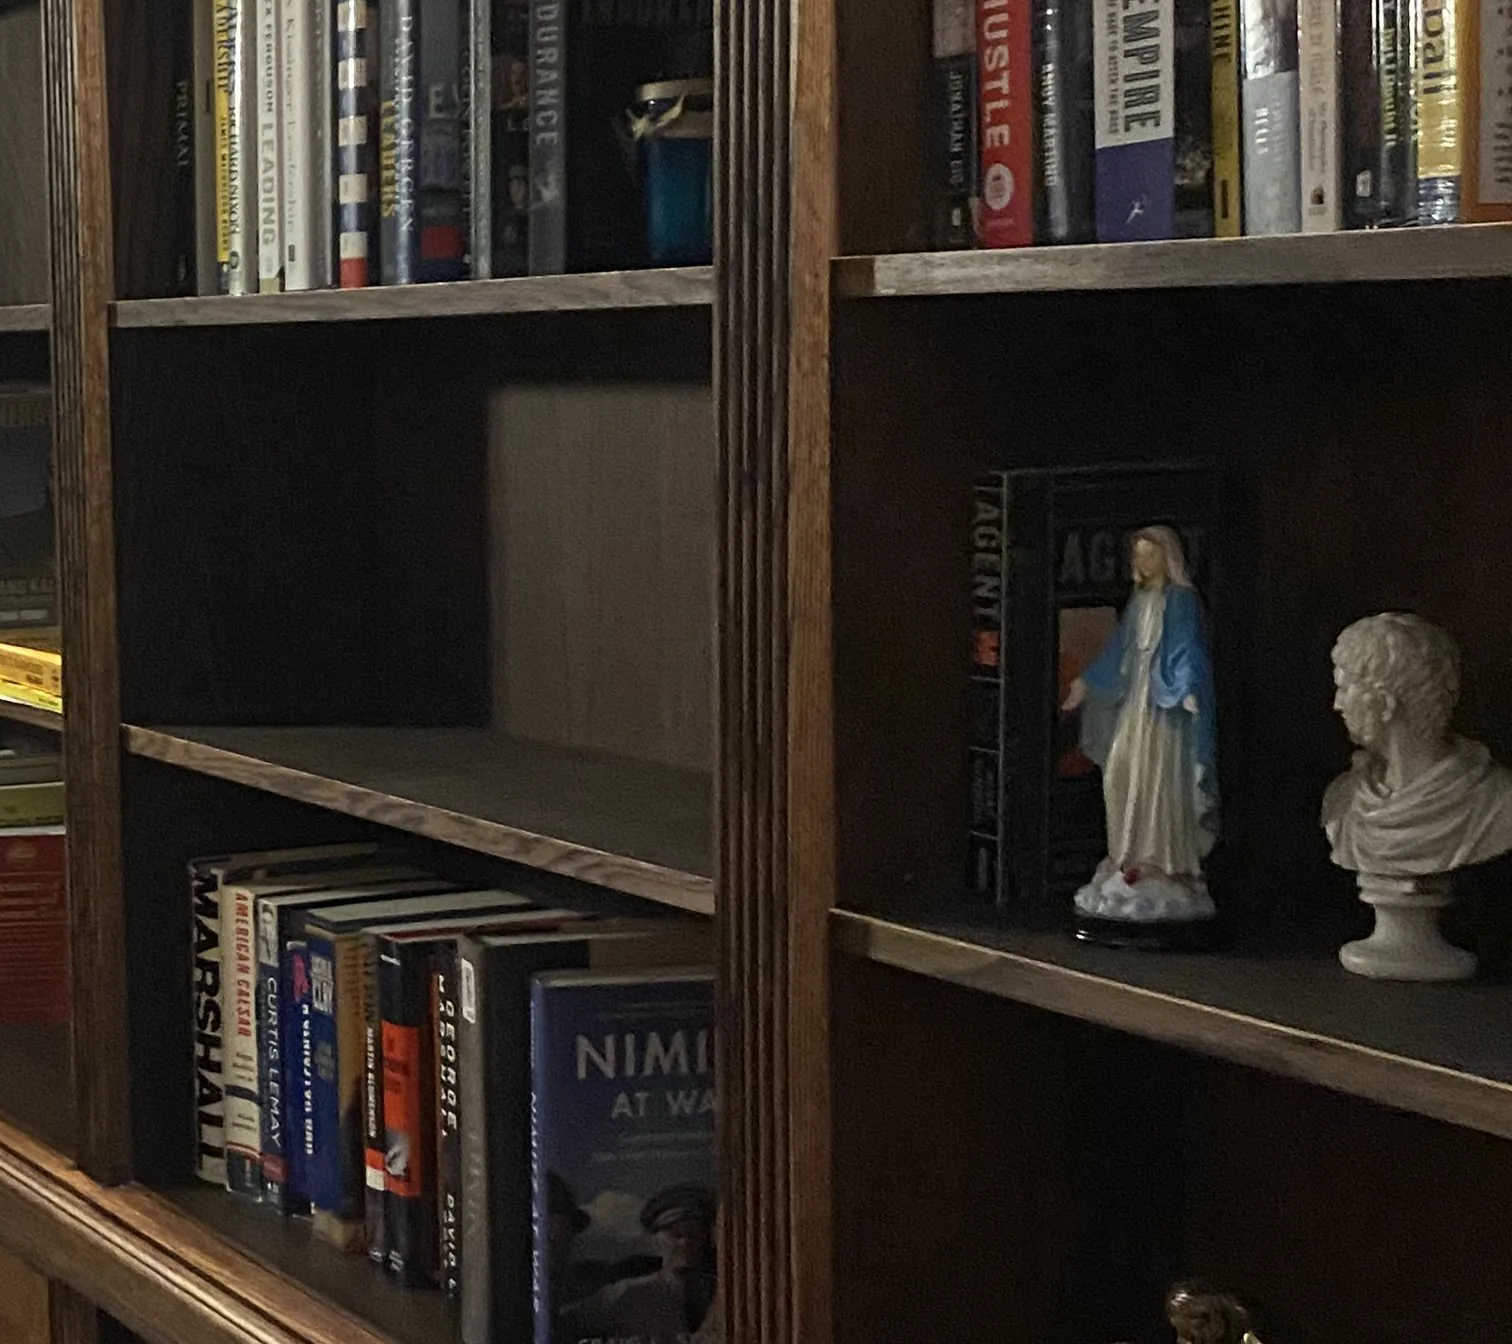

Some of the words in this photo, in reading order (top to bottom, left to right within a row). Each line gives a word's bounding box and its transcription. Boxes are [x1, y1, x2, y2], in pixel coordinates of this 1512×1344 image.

[266, 24, 275, 112] FERGUSON
[401, 15, 414, 103] DAVID
[228, 106, 240, 181] RICHARD
[261, 123, 276, 245] LEADING
[401, 118, 415, 231] GERGEN
[1043, 111, 1060, 187] MARTINO
[229, 185, 240, 234] NIXON
[972, 501, 1000, 618] AGENT
[235, 894, 250, 973] AMERICAN
[194, 871, 223, 1170] MARSHALL
[237, 979, 252, 1036] CAESAR
[268, 977, 280, 1056] CURTIS
[447, 1000, 457, 1130] GEORGE
[610, 1091, 650, 1119] AT
[268, 1068, 281, 1149] LEMAY
